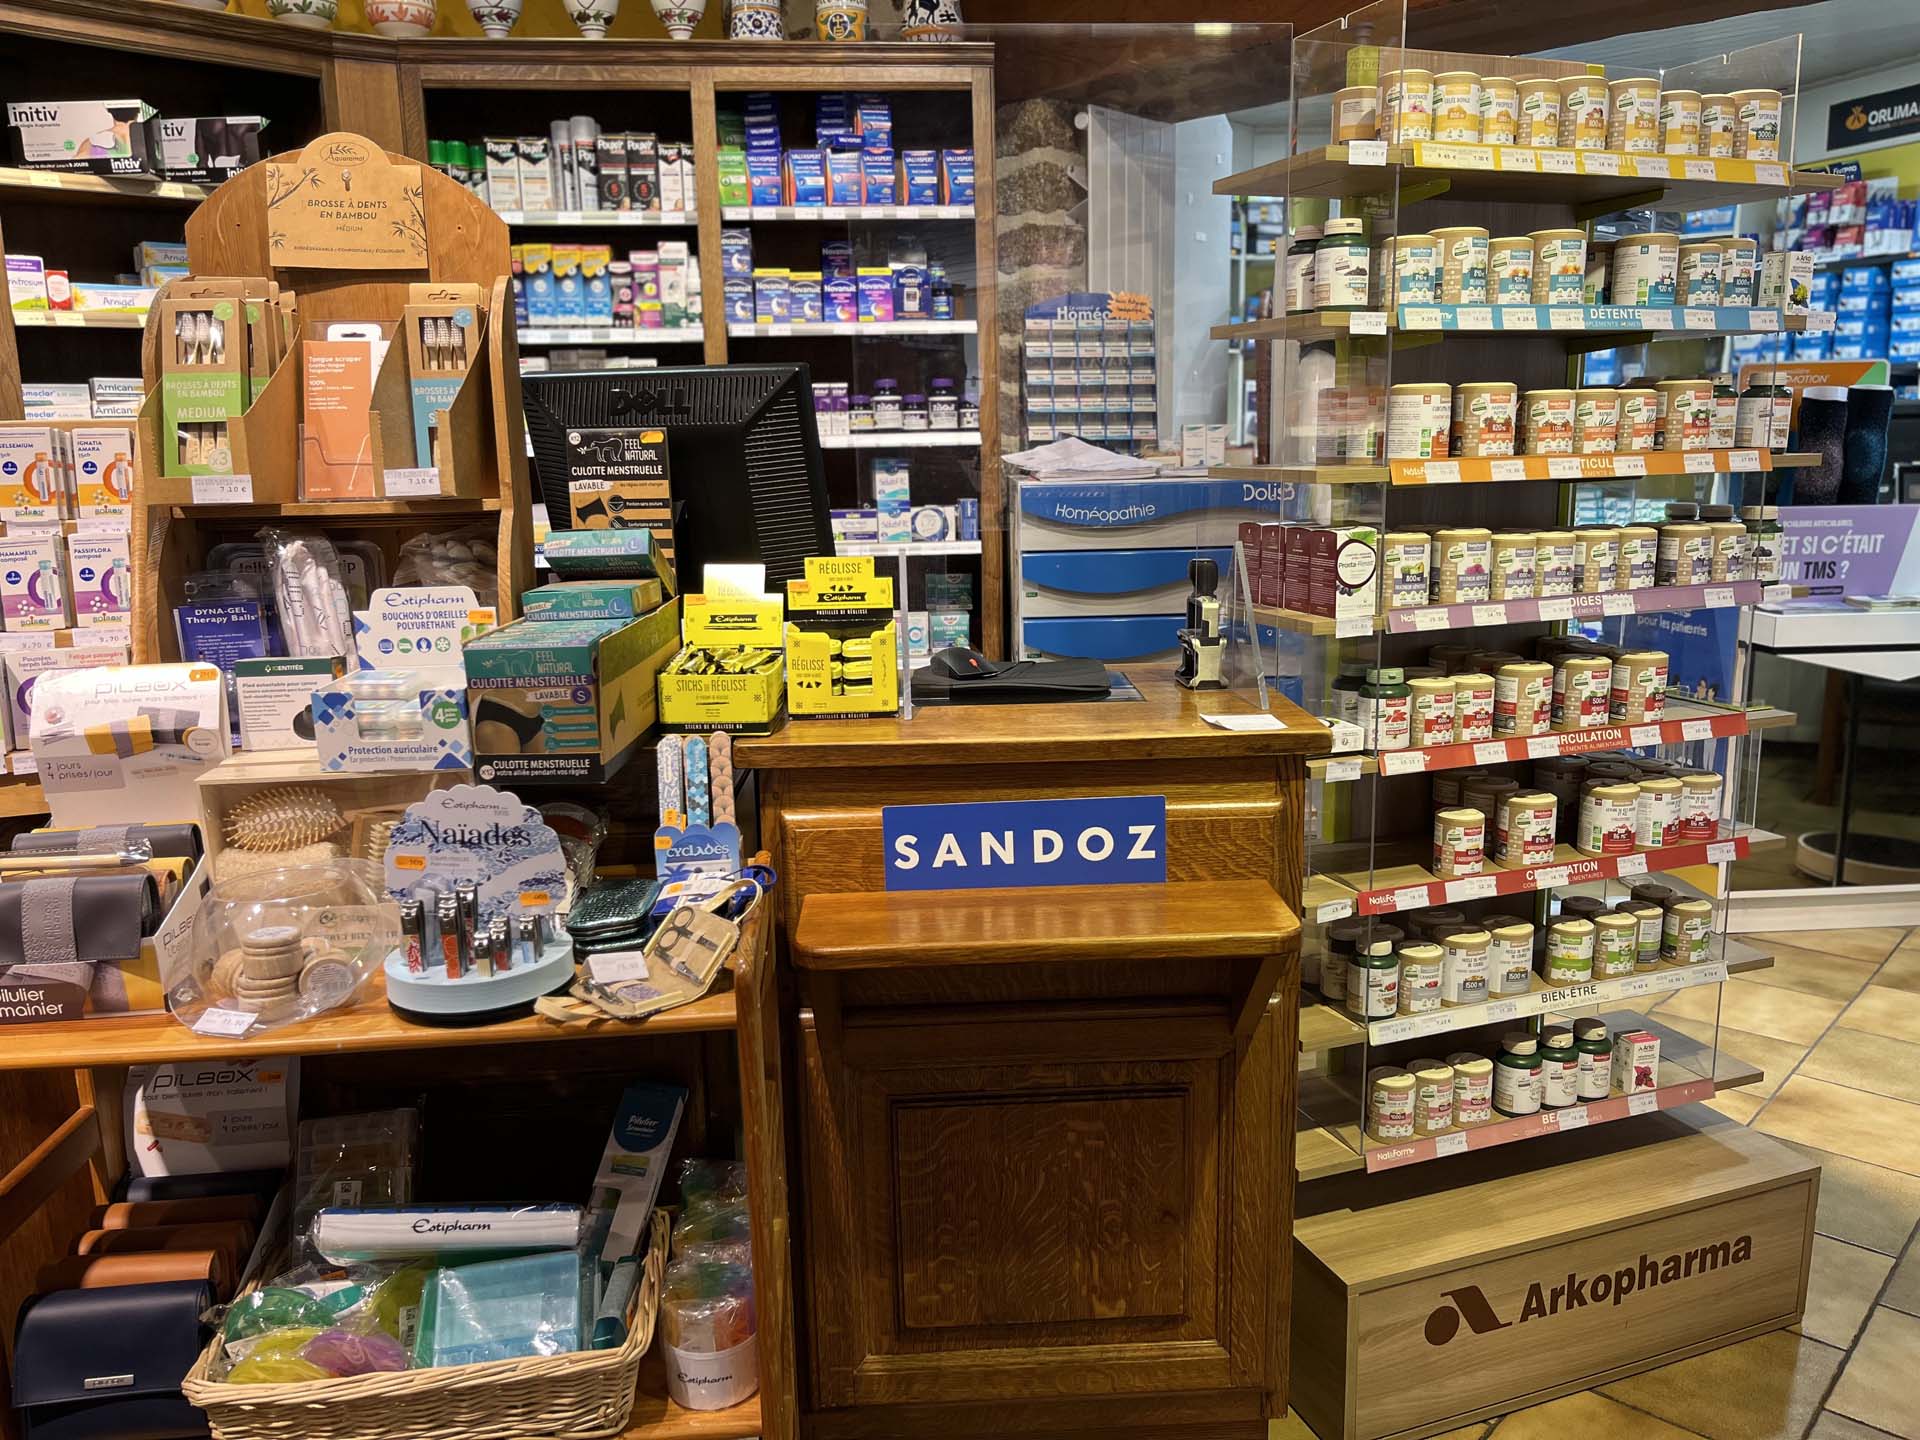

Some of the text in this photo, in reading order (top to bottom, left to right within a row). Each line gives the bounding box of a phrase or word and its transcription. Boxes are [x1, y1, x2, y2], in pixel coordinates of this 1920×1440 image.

[12, 106, 58, 122] initiv
[1868, 101, 1920, 125] ORLIMA
[111, 158, 140, 170] initiv
[307, 200, 345, 209] BROSSE
[357, 201, 388, 209] DENTS
[319, 211, 377, 220] EN BAMBOU
[756, 281, 789, 291] Novanuit
[790, 285, 821, 294] Novanuit
[825, 283, 857, 292] Novanuit
[859, 281, 891, 291] Novanuit
[1590, 306, 1641, 319] DÉTENTE
[1786, 374, 1829, 383] MOTION
[96, 383, 134, 393] Arnican
[166, 380, 238, 391] BROSSES DENTS
[415, 387, 449, 396] BROSSES
[189, 390, 225, 398] BAMBOU
[610, 389, 693, 416] DELL
[95, 405, 133, 415] Arnican
[177, 407, 226, 418] MEDIUM
[624, 438, 643, 450] FEEL
[624, 449, 659, 461] NATURAL
[571, 465, 664, 476] CULOTTE MENSTRUELLE
[574, 481, 606, 491] LAVABLE
[1055, 503, 1156, 523] Homéopathie
[1783, 529, 1886, 555] ET SI C'ÉTAIT
[818, 561, 863, 574] RÉGLISSE
[1804, 560, 1837, 580] TMS
[1840, 559, 1850, 579] ?
[384, 592, 465, 609] Estipharm
[823, 593, 862, 603] Estipharm
[194, 607, 248, 616] DYNA-GEL
[382, 610, 468, 621] BOUCHONS D'OREILLES
[527, 603, 621, 621] CULOTTE MENSTRUELLE L
[186, 616, 228, 624] Therapy
[715, 614, 753, 625] Estipharm
[1636, 615, 1709, 638] pour les patients
[536, 650, 556, 662] FEEL
[537, 663, 576, 674] NATURAL
[791, 656, 825, 671] RÉGLISSE
[470, 675, 588, 689] CULOTTE MENSTRUELLE
[711, 677, 748, 692] RÉGLISSE
[534, 689, 586, 702] LAVABLE S
[434, 711, 445, 723] 4
[348, 744, 439, 754] Protection auriculaire
[56, 762, 82, 771] jours
[493, 758, 590, 770] CULOTTE MENSTRUELLE
[58, 769, 113, 780] prises/jour
[531, 769, 557, 778] pendant
[568, 768, 588, 778] règles
[440, 798, 501, 811] Estipharm
[420, 820, 533, 848] Naïades
[893, 825, 1157, 871] SANDOZ
[1567, 872, 1605, 882] LIMENTAIRES
[0, 988, 45, 1002] ilulier
[1541, 985, 1598, 1004] BIEN-ÊTRE
[0, 1002, 64, 1017] mainier
[411, 1218, 492, 1235] Estipharm
[1519, 1234, 1753, 1323] Arkopharma
[676, 1372, 734, 1386] Estipharm
